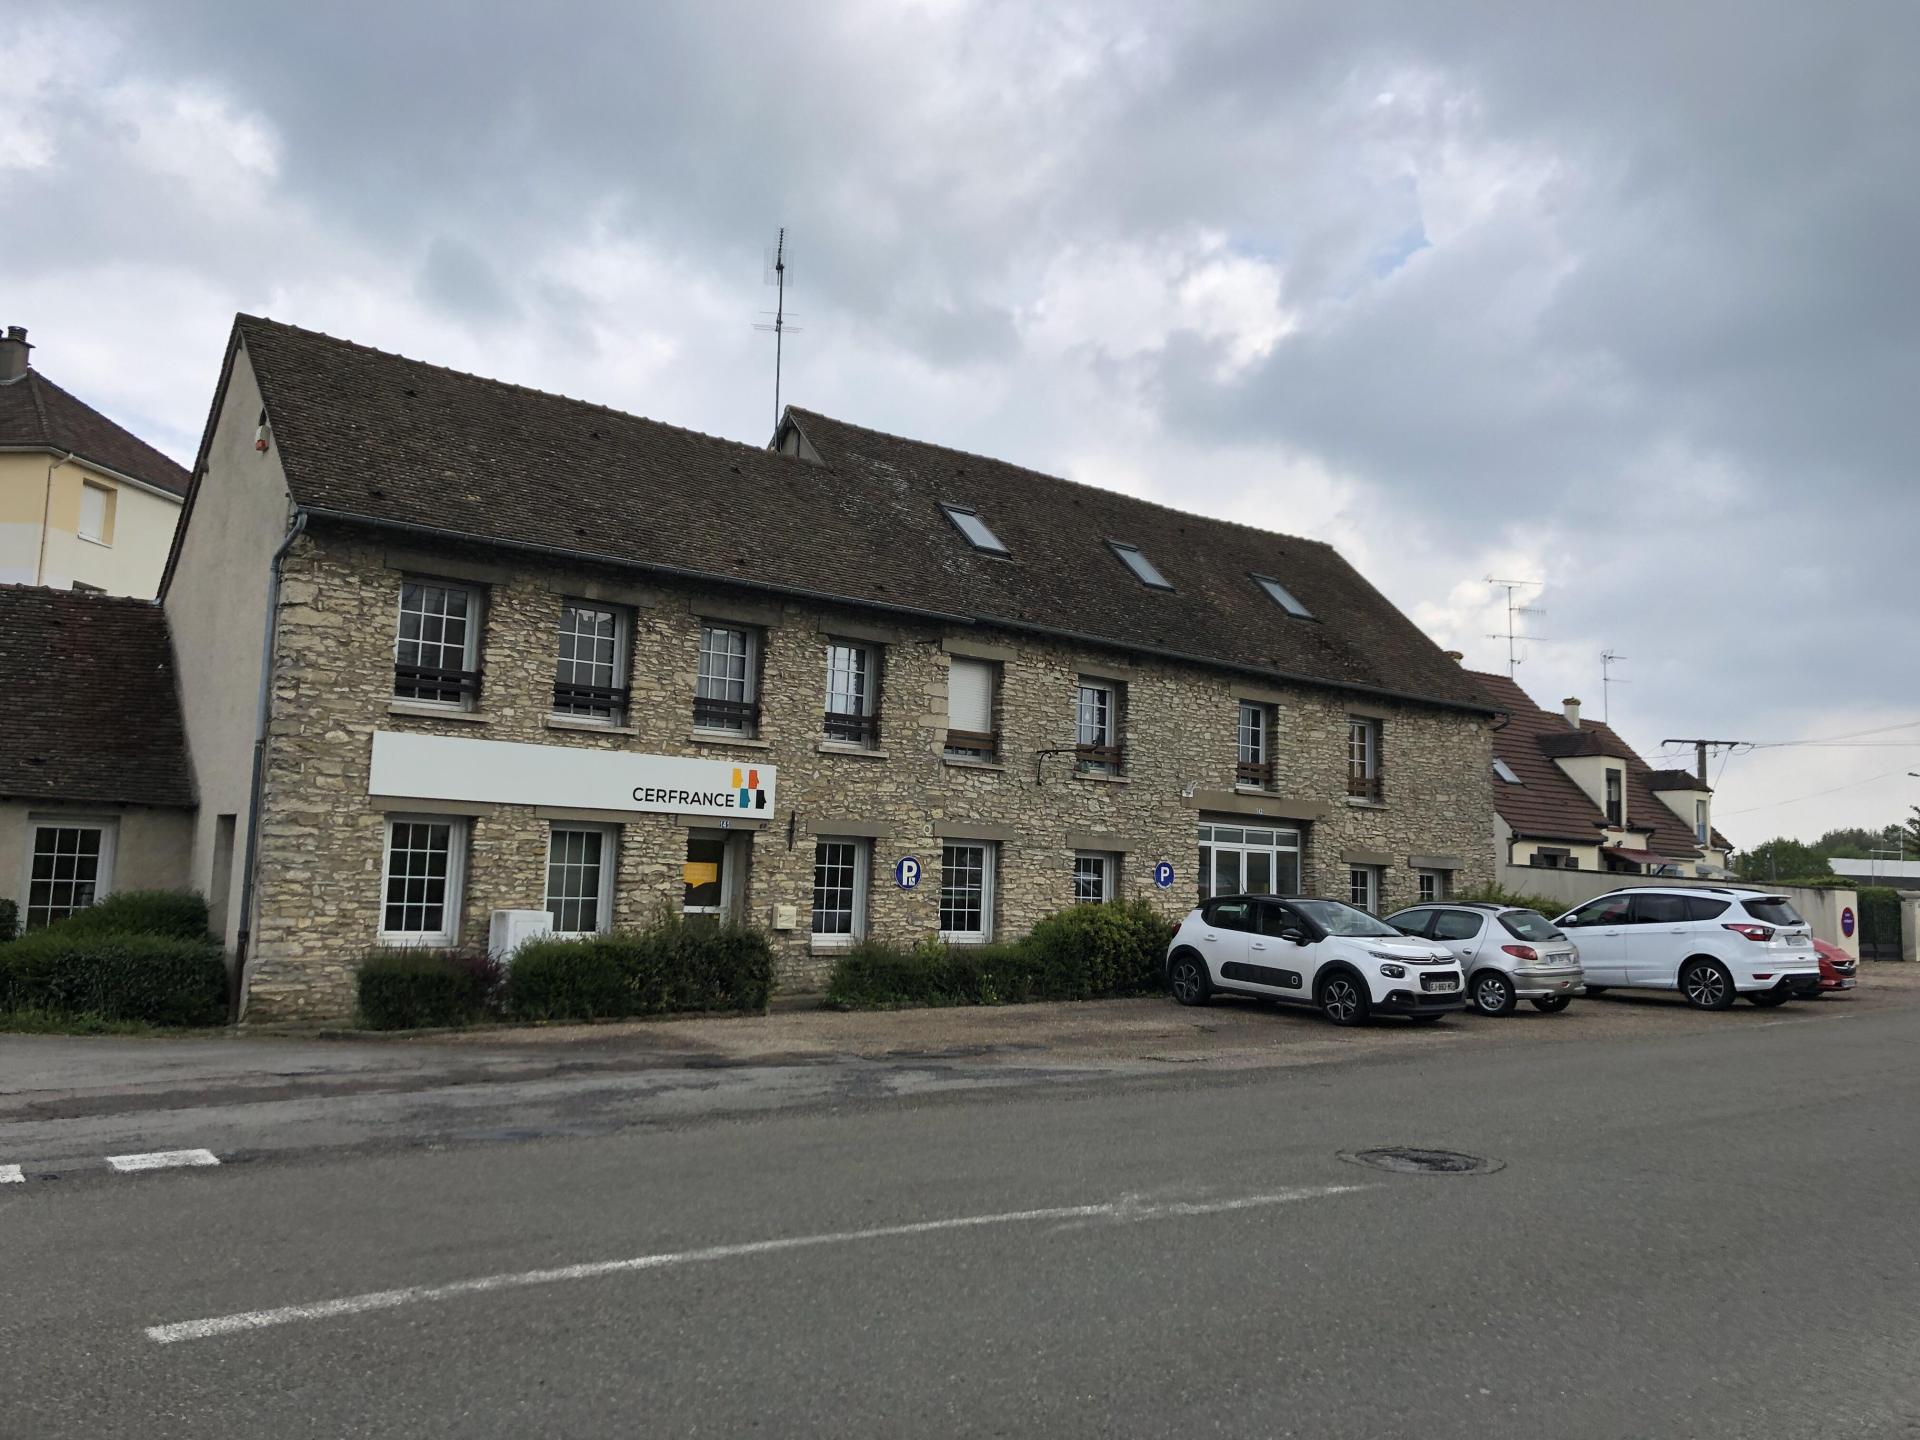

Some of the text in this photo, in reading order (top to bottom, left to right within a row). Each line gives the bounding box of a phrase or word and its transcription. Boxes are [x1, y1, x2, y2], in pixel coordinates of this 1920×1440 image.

[632, 787, 735, 807] CERFRANCE
[902, 860, 917, 886] P
[1160, 866, 1170, 882] P
